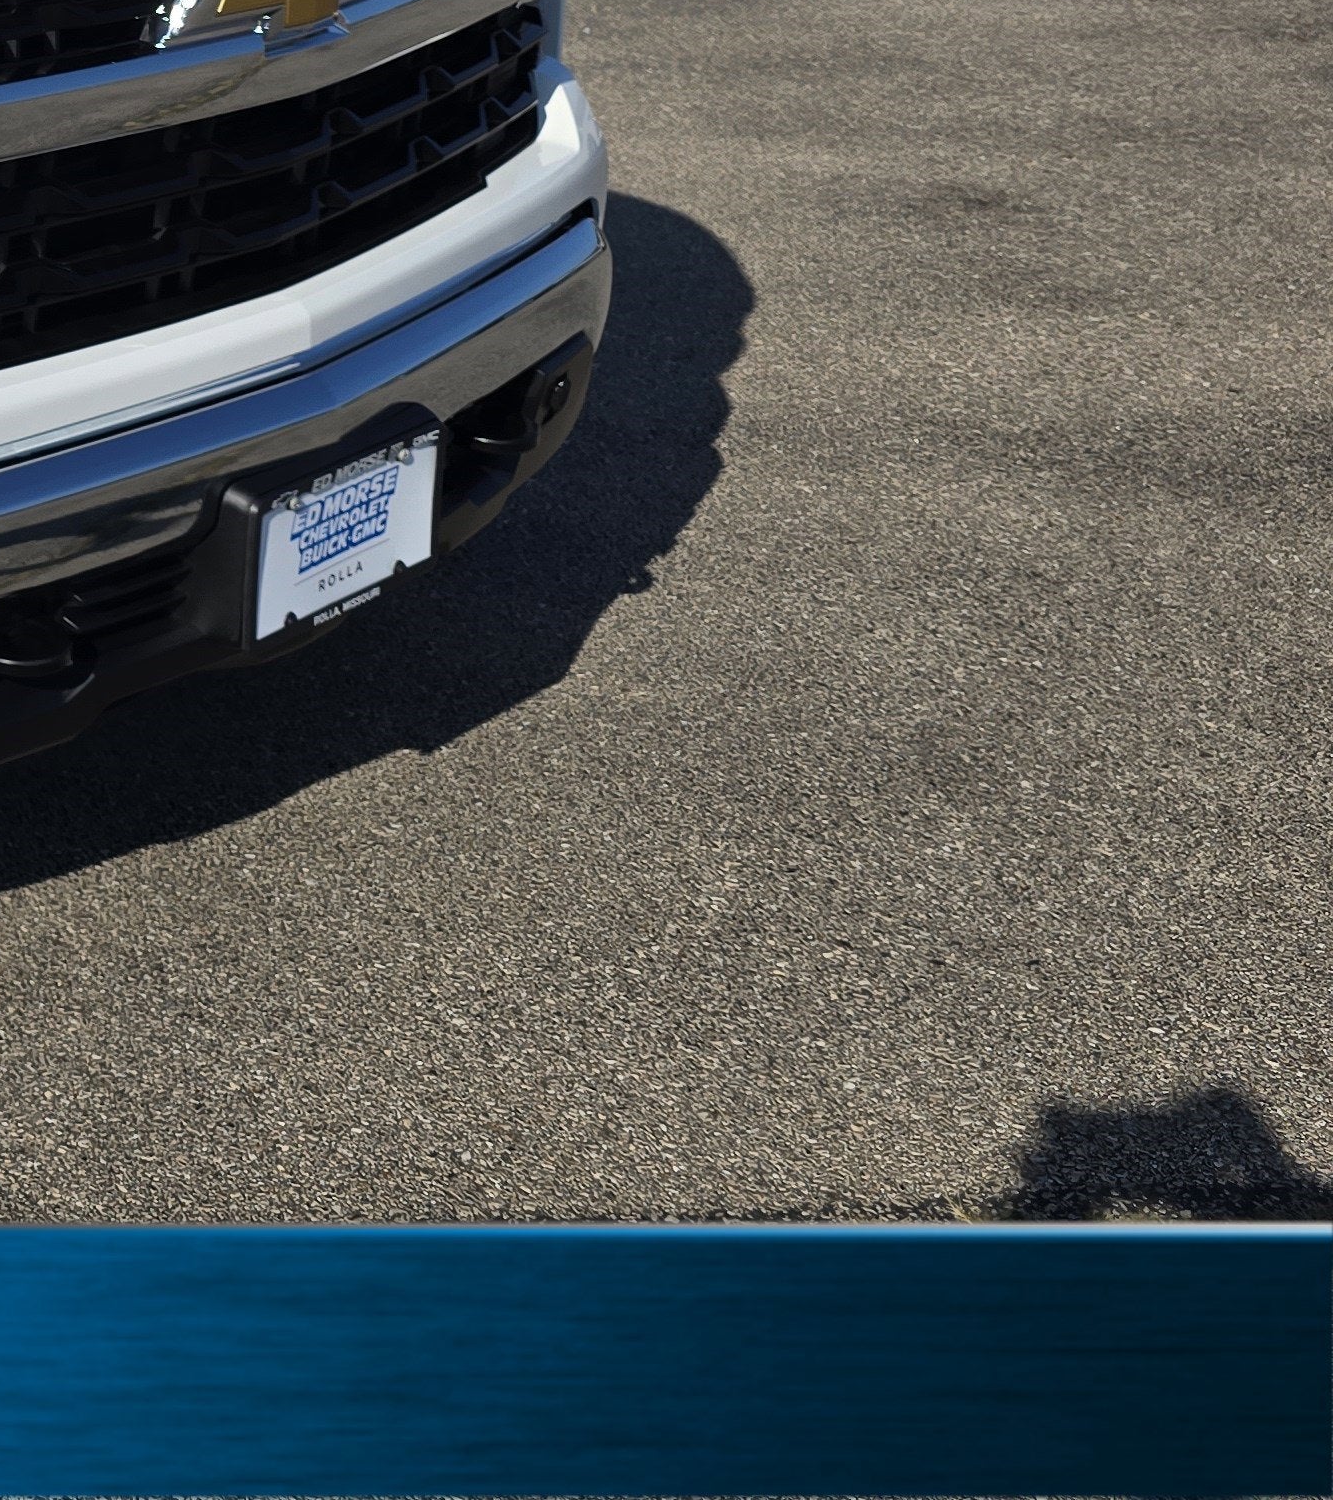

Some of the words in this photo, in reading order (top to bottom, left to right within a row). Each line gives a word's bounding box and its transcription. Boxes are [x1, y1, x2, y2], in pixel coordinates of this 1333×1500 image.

[292, 501, 322, 536] ED
[321, 467, 399, 520] MORSE
[299, 496, 390, 551] CHEVROLET
[318, 560, 363, 592] ROLLA
